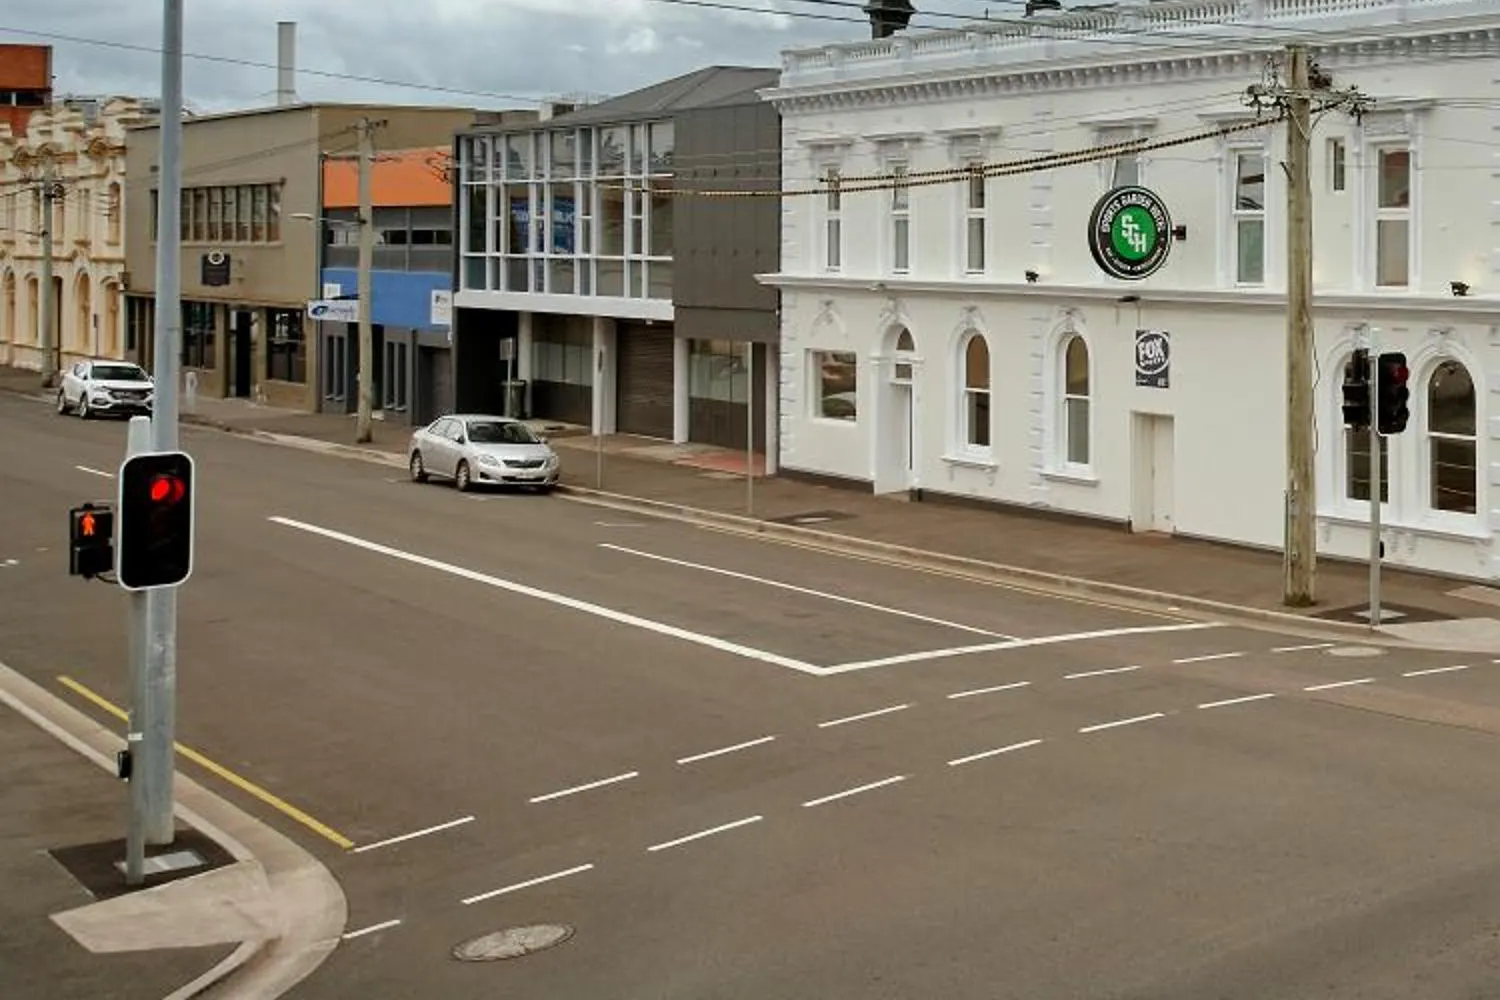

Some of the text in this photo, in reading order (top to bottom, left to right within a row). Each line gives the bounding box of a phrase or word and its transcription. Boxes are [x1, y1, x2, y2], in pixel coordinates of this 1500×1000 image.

[1101, 199, 1121, 233] SPORTS
[1121, 214, 1147, 253] SGH
[1138, 337, 1165, 362] FOX
